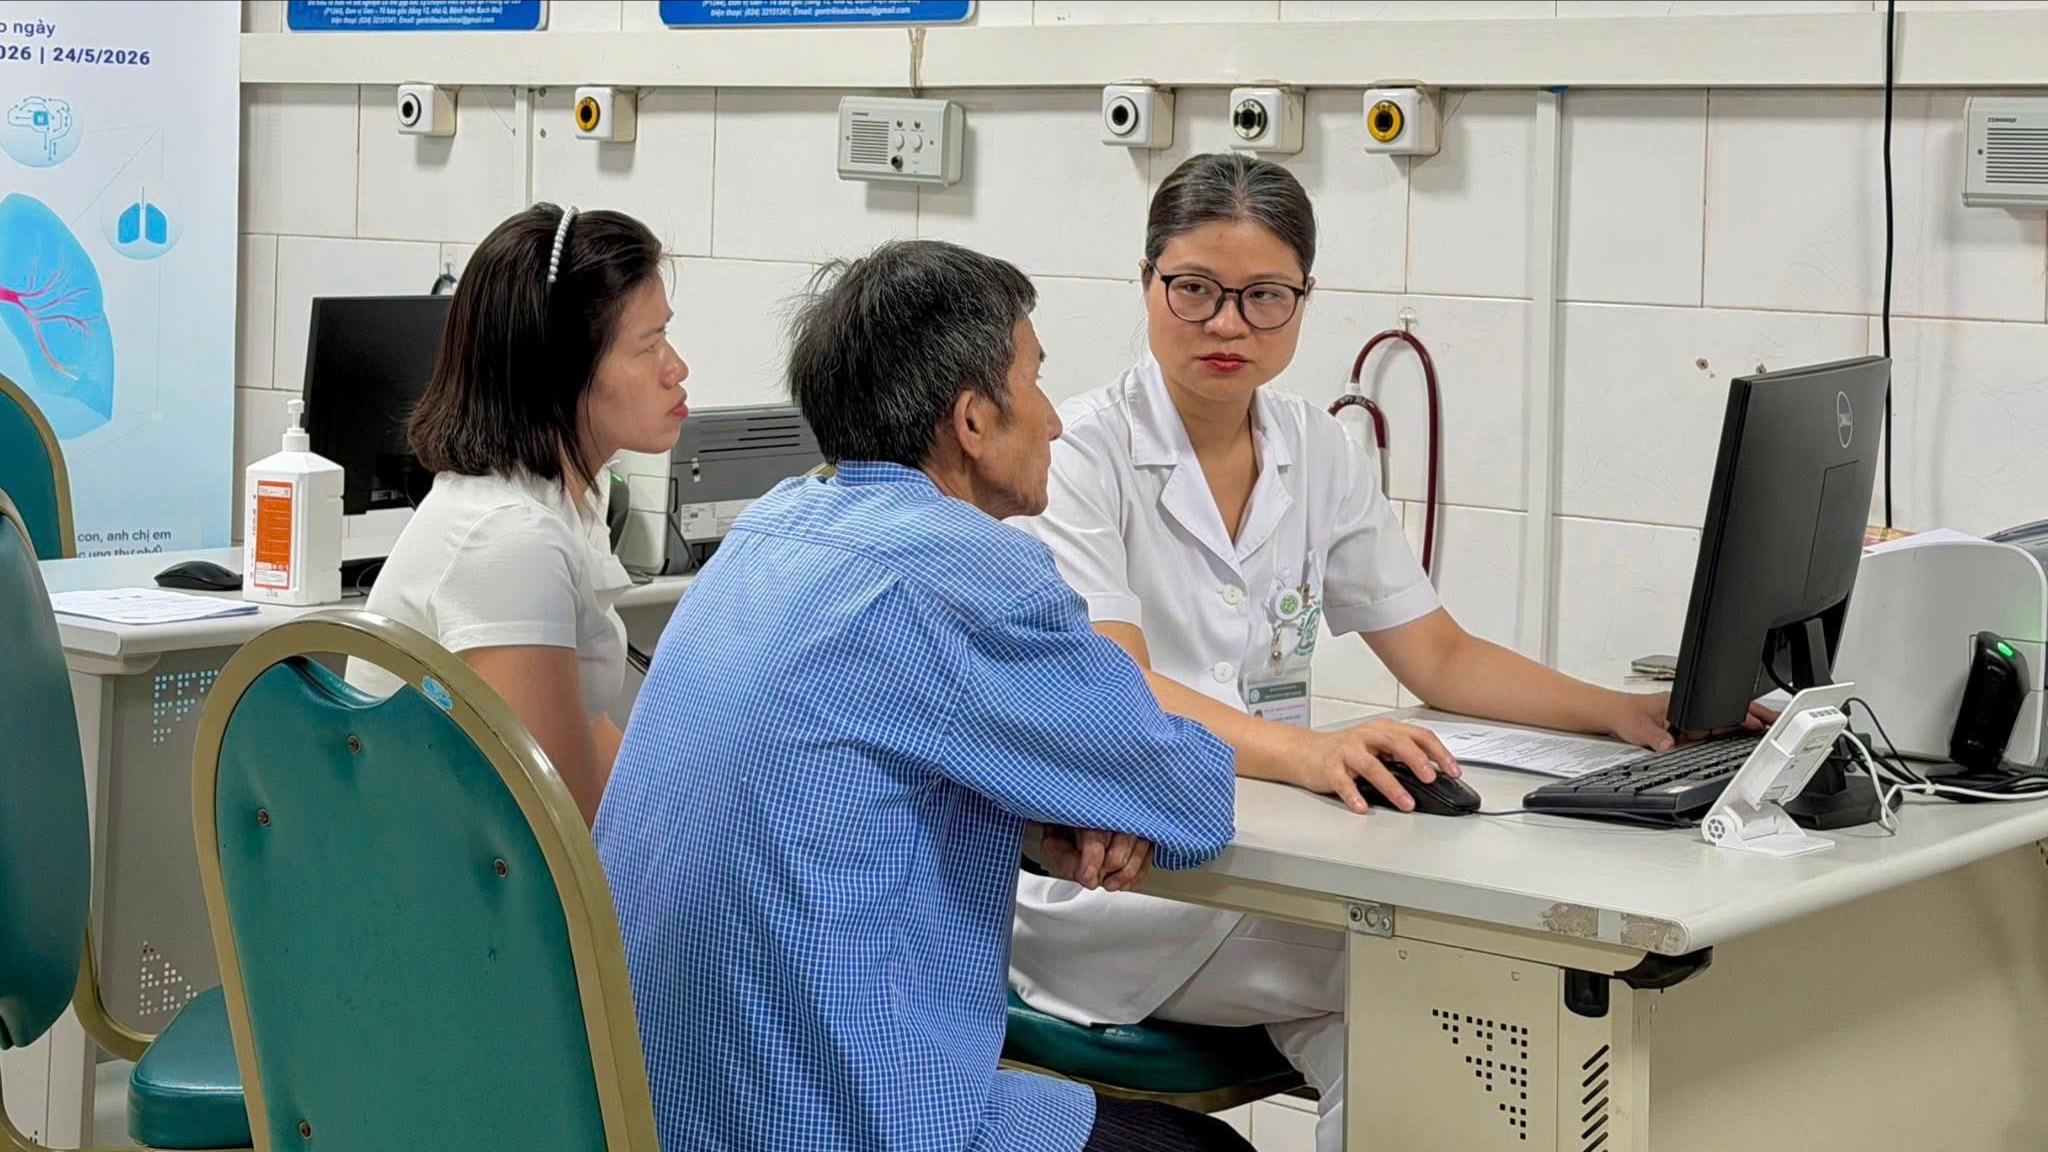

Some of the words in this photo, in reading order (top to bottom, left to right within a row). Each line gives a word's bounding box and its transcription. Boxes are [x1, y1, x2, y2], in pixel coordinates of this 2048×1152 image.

[13, 19, 56, 38] ngày
[52, 47, 150, 65] 24/5/2026
[78, 533, 103, 543] con,
[107, 530, 128, 541] anh
[132, 528, 150, 542] chị
[152, 530, 172, 540] em
